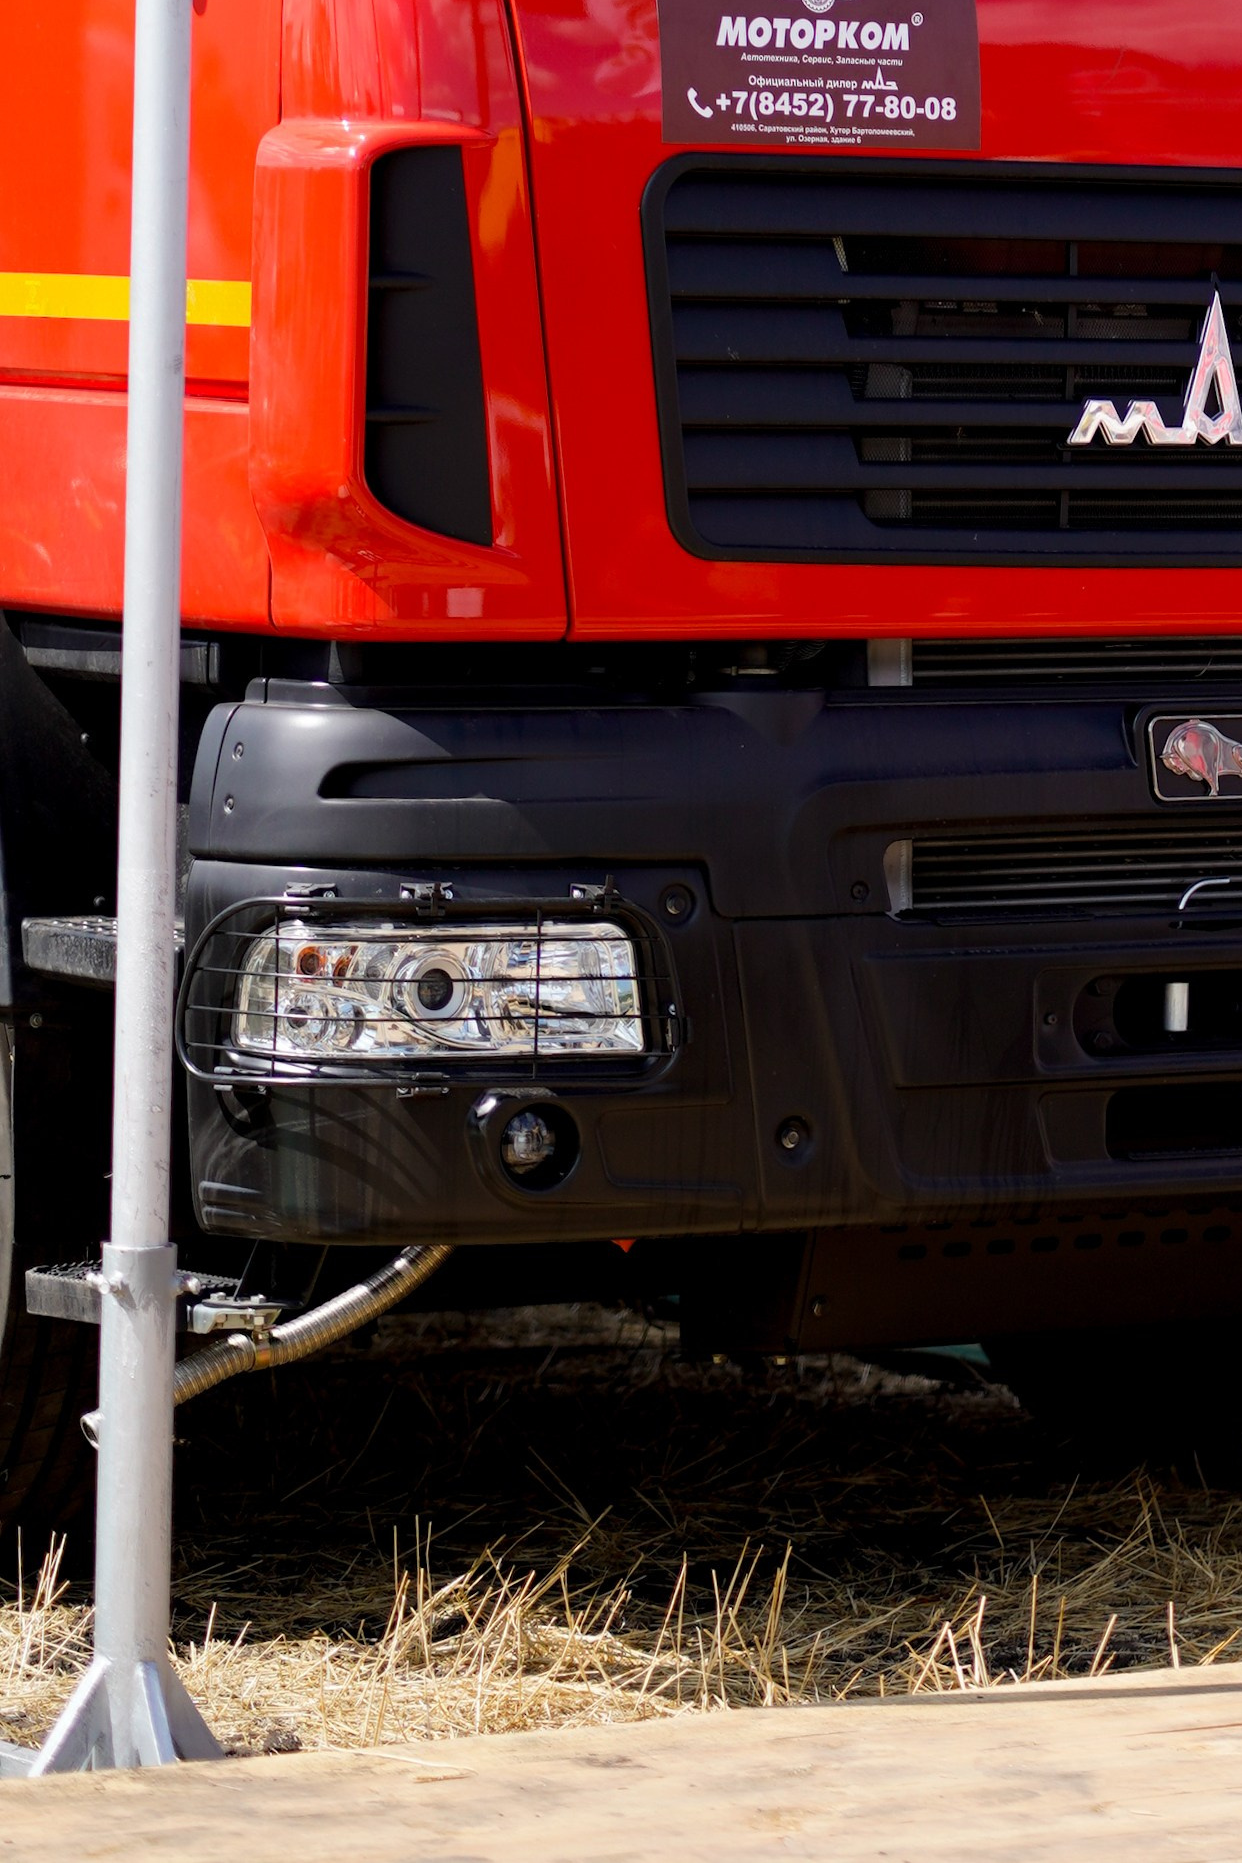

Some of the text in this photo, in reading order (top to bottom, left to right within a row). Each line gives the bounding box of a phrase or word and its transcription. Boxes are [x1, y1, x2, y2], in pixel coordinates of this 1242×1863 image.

[716, 16, 910, 51] МОТОРКОМ
[740, 52, 903, 67] Автотехника, Сервис, Запасные части
[748, 74, 824, 89] Официальный
[826, 78, 858, 90] дилер
[715, 90, 957, 123] +7(8452) 77-80-08
[758, 124, 804, 134] Саратовский
[805, 126, 828, 135] район,
[830, 126, 850, 136] Хутор
[852, 127, 915, 137] Бартоломеевский,
[786, 135, 797, 144] ул.
[798, 135, 830, 144] Озерная,
